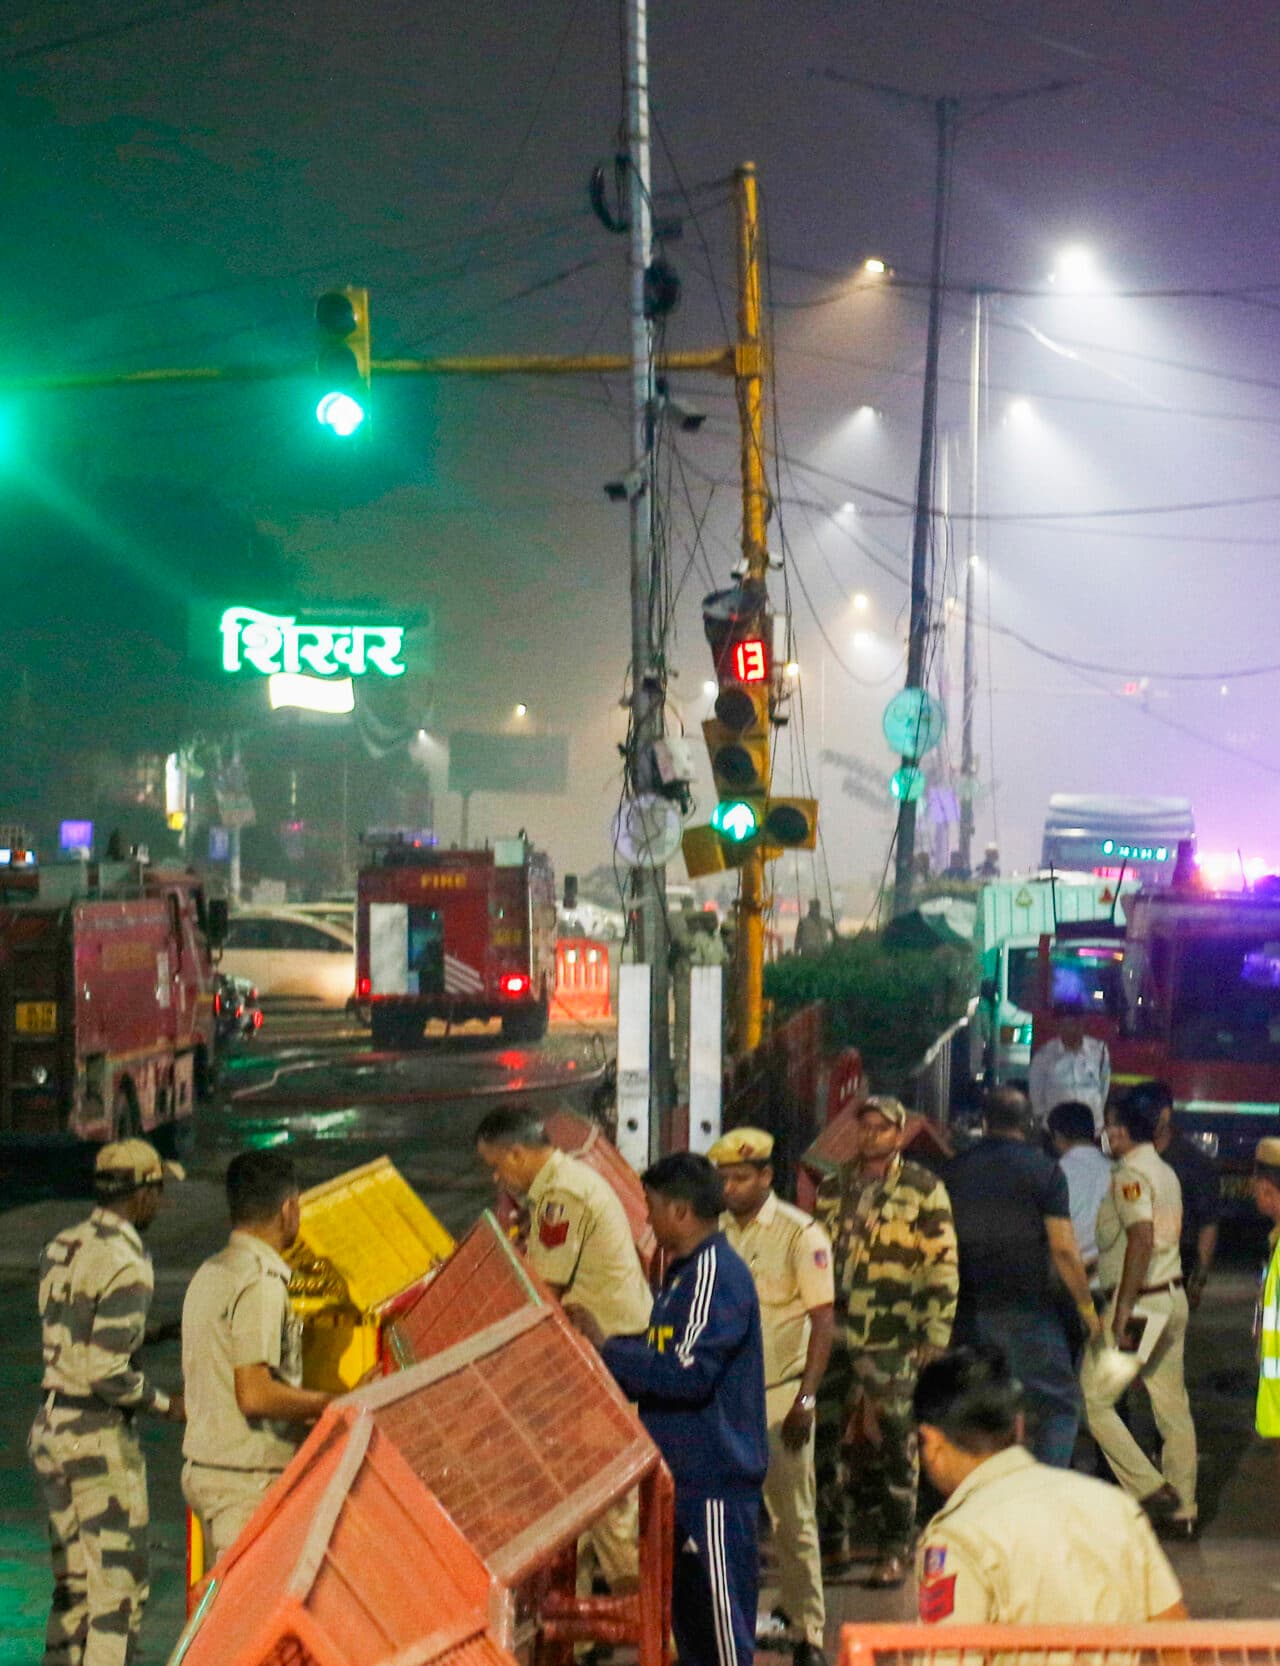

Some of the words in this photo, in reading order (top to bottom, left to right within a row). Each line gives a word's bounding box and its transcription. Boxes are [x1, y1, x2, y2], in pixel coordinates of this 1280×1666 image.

[220, 606, 405, 676] शिखर
[737, 641, 765, 681] 13
[421, 874, 467, 888] FIRE
